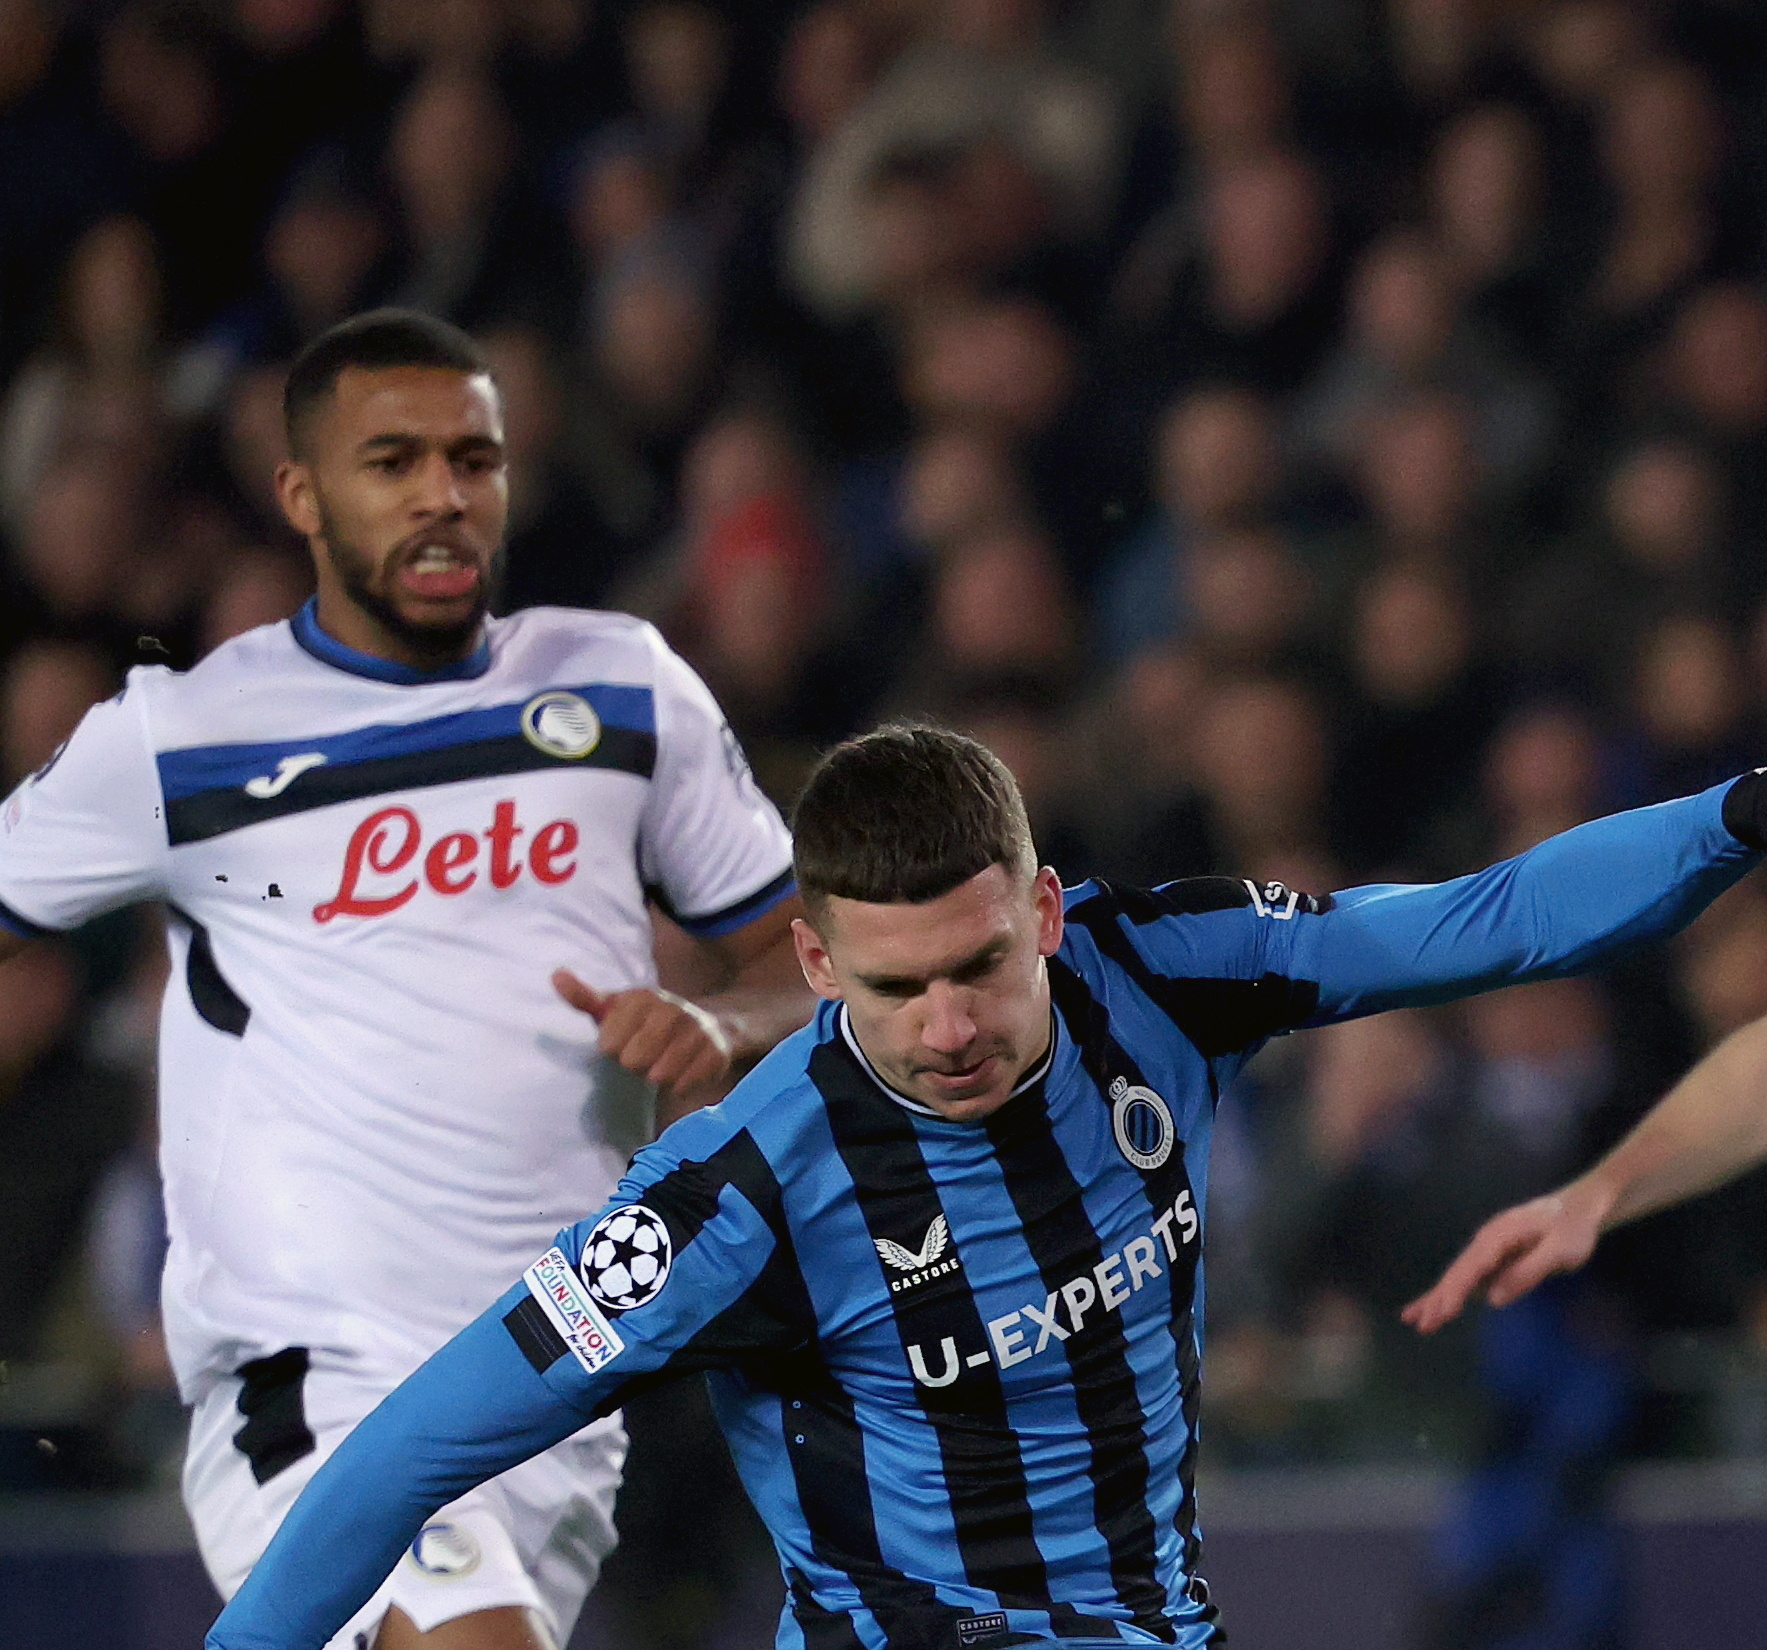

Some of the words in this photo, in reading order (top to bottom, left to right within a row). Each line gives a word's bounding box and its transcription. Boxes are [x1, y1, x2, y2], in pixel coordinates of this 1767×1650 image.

[311, 796, 581, 925] Lete
[535, 1256, 613, 1363] FOUNDATION
[549, 1250, 566, 1272] UEFA
[891, 1257, 960, 1292] CASTORE
[906, 1188, 1199, 1389] U-EXPERTS
